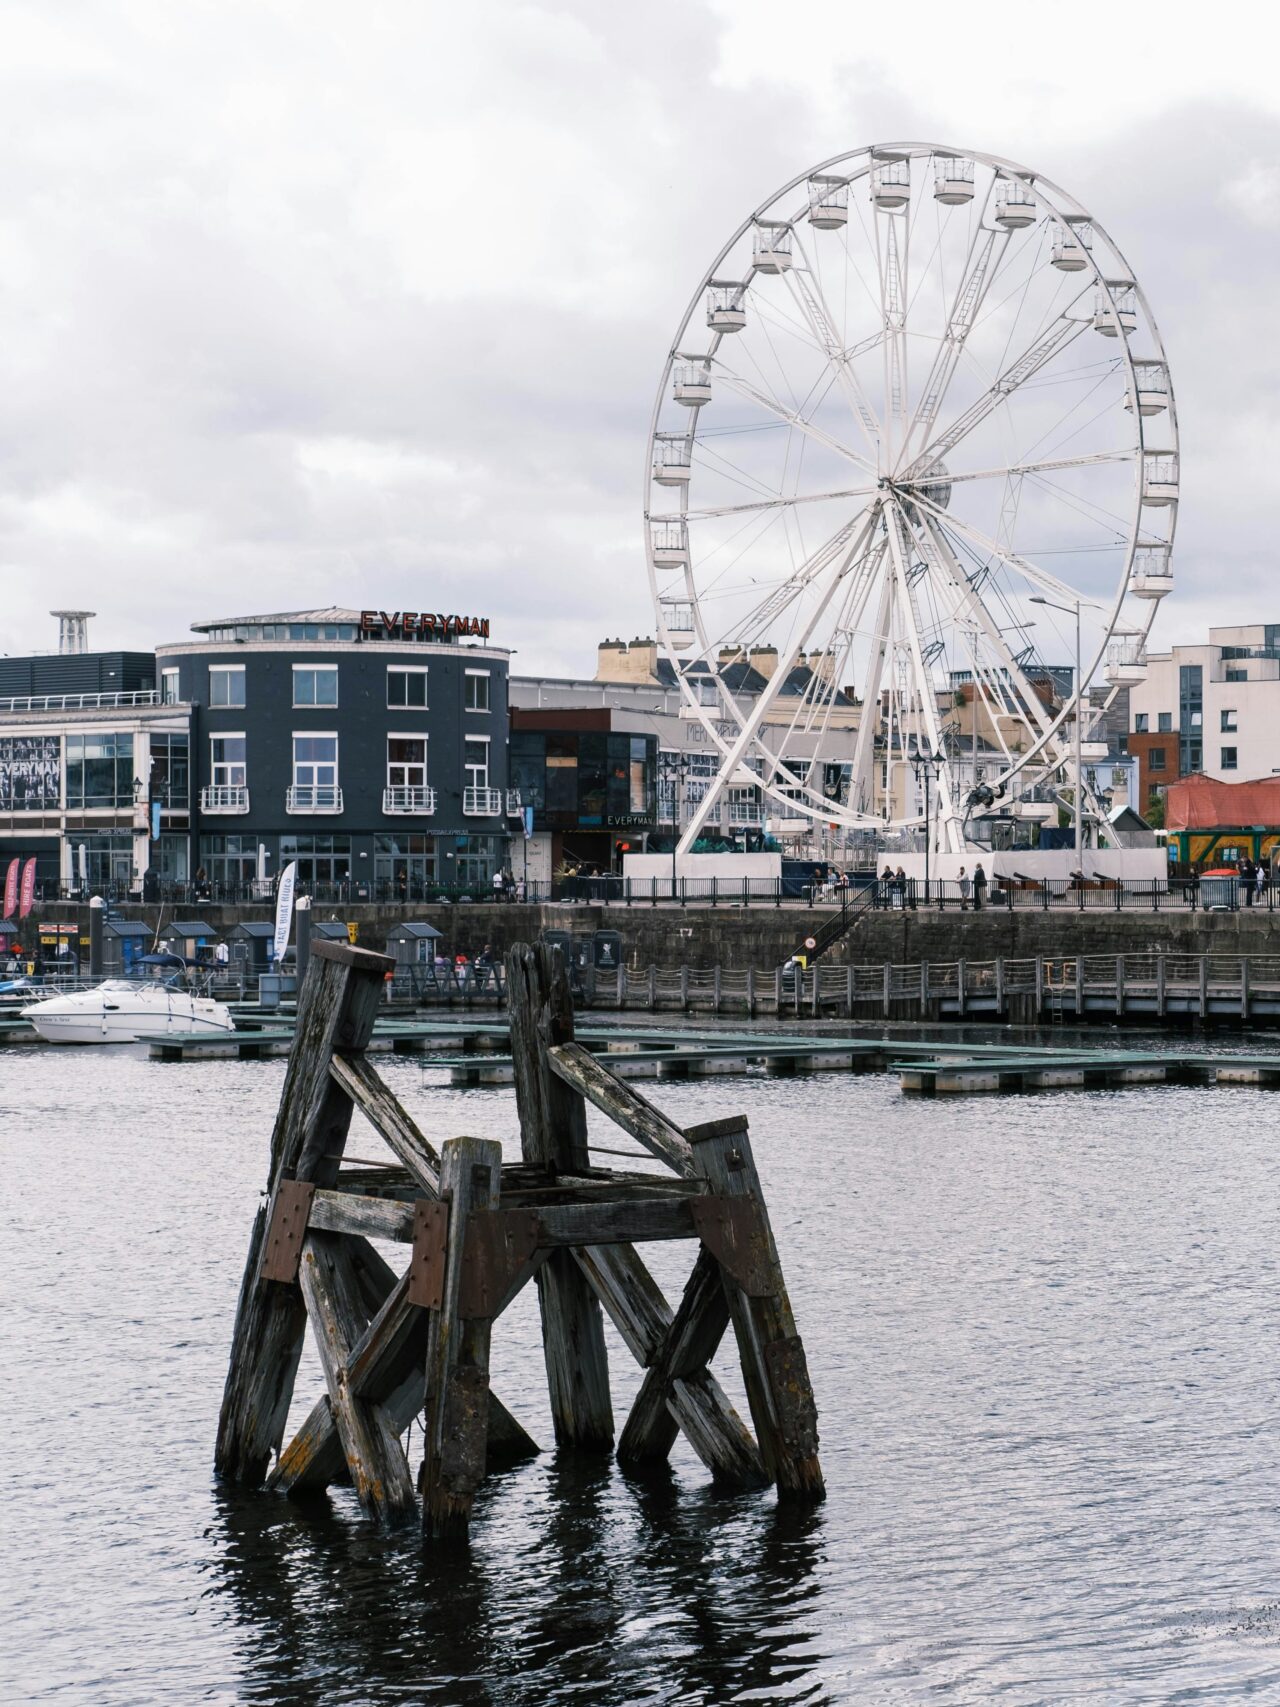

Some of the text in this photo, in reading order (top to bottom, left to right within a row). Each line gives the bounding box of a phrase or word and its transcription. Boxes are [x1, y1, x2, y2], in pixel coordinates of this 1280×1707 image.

[361, 611, 489, 638] EVERYMAN
[22, 864, 33, 906] HIRE BOATS
